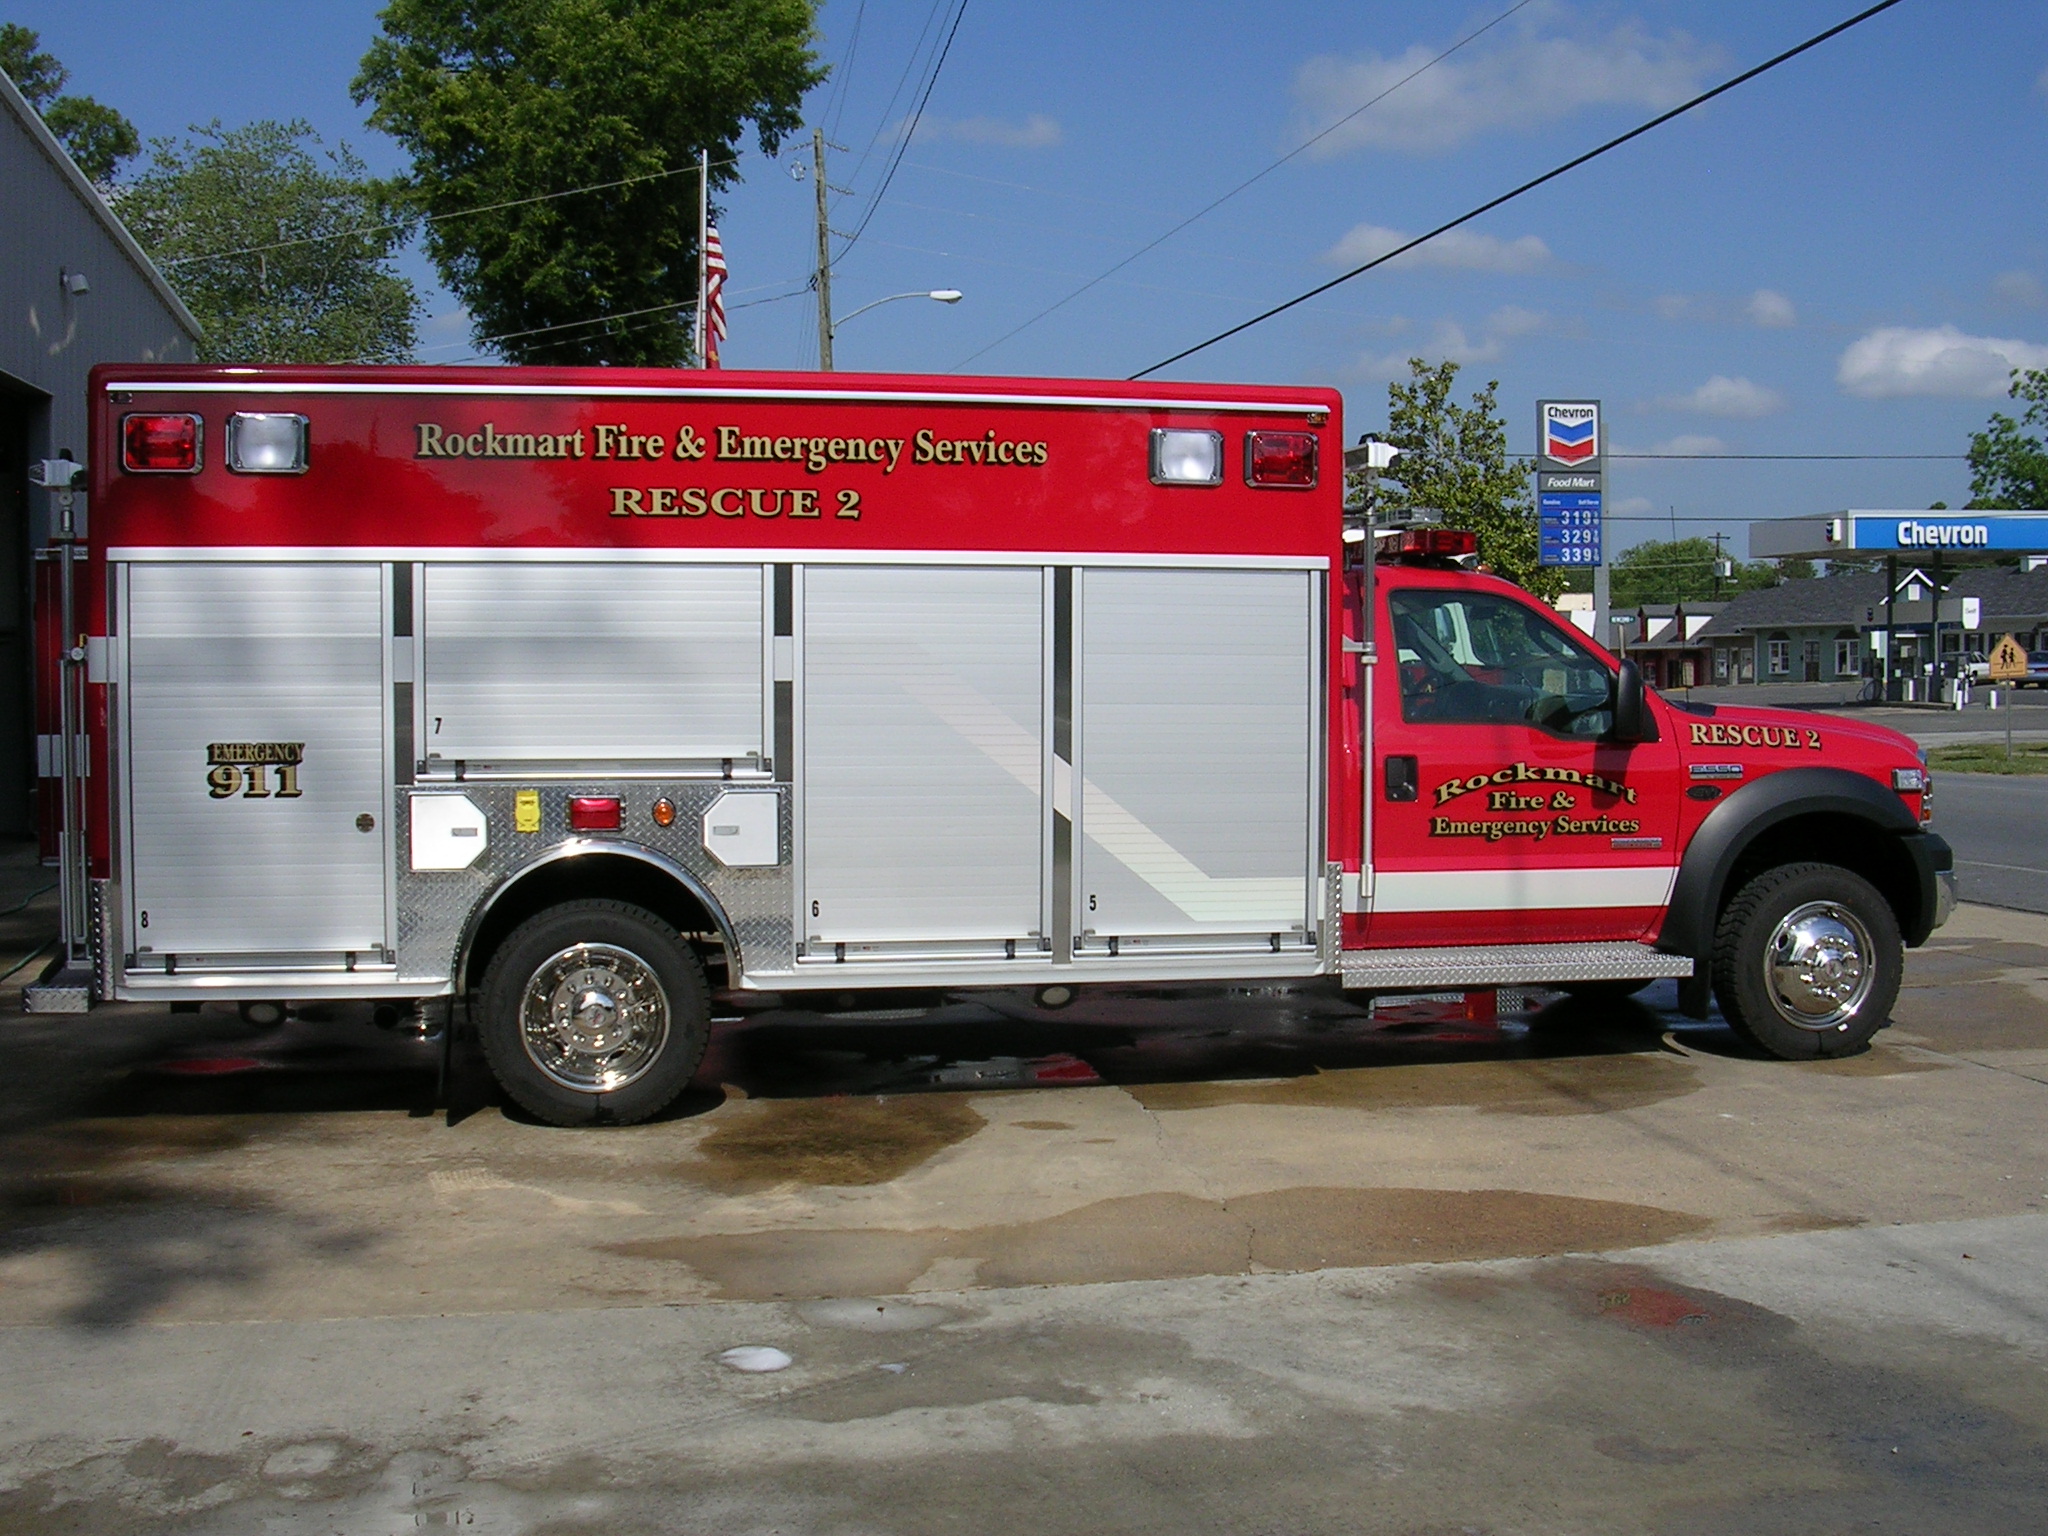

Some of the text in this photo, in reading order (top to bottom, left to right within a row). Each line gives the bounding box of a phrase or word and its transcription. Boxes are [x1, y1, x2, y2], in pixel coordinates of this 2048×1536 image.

[1548, 406, 1594, 418] Chevron
[416, 422, 1049, 473] Rockmart Fire & Emergency Services
[1547, 476, 1596, 488] Food Mart
[609, 487, 861, 520] RESCUE 2
[1897, 520, 1988, 546] Chevron
[434, 717, 443, 735] 7
[1689, 722, 1821, 750] RESCUE 2
[206, 742, 305, 765] EMERGENCY
[207, 763, 303, 799] 911
[1434, 761, 1638, 807] Rockmart
[1487, 789, 1575, 811] Fire &
[1430, 815, 1640, 842] Emergency Services
[811, 900, 820, 917] 6
[1088, 894, 1097, 911] 5
[141, 910, 149, 928] 8
